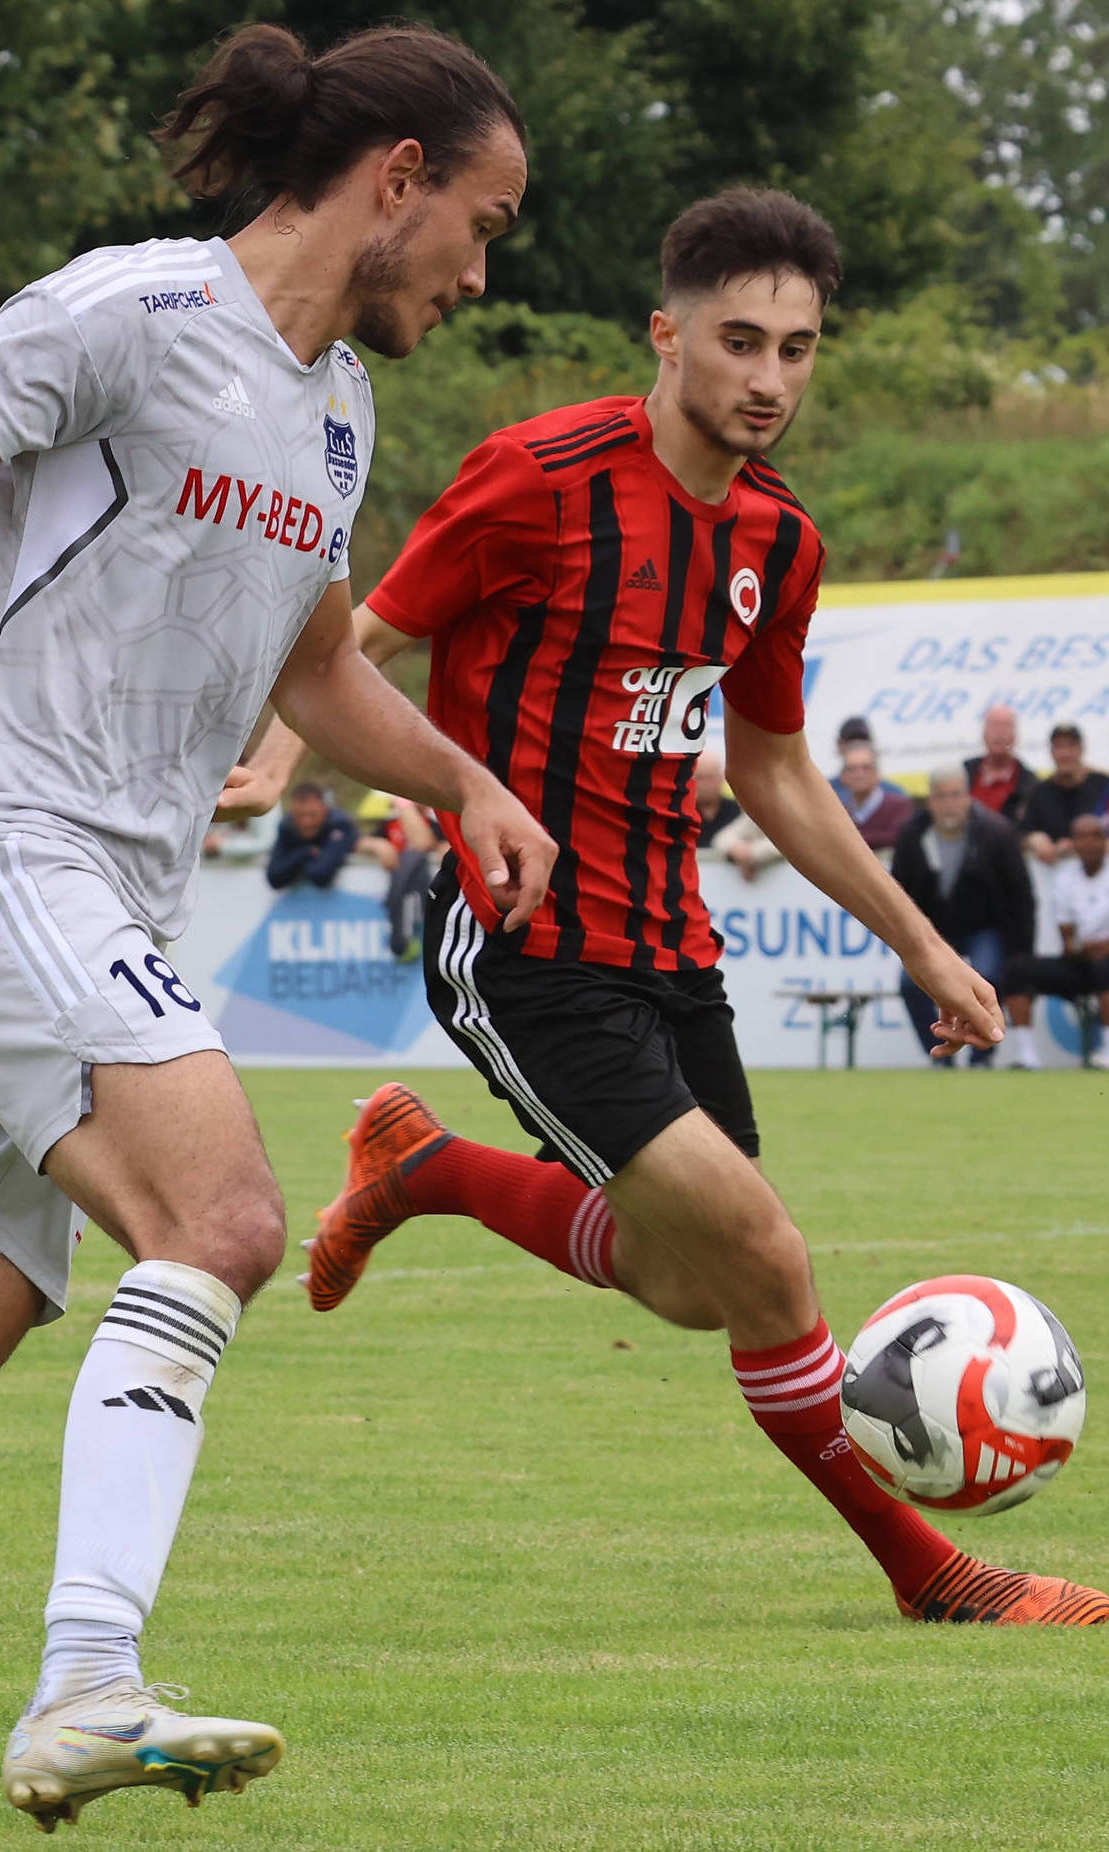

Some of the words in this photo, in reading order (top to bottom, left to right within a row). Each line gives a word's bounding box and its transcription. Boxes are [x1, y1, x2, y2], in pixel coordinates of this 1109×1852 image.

[139, 282, 218, 314] TARIFCHECK
[212, 397, 256, 419] adidas
[175, 466, 348, 563] MY-BED.e
[626, 578, 662, 592] adidas
[898, 636, 1010, 673] DAS
[622, 667, 685, 693] OUT
[630, 693, 669, 723] FIT
[865, 683, 970, 724] FÜR
[612, 721, 660, 753] TER
[710, 909, 893, 957] SUND
[109, 952, 201, 1018] 18
